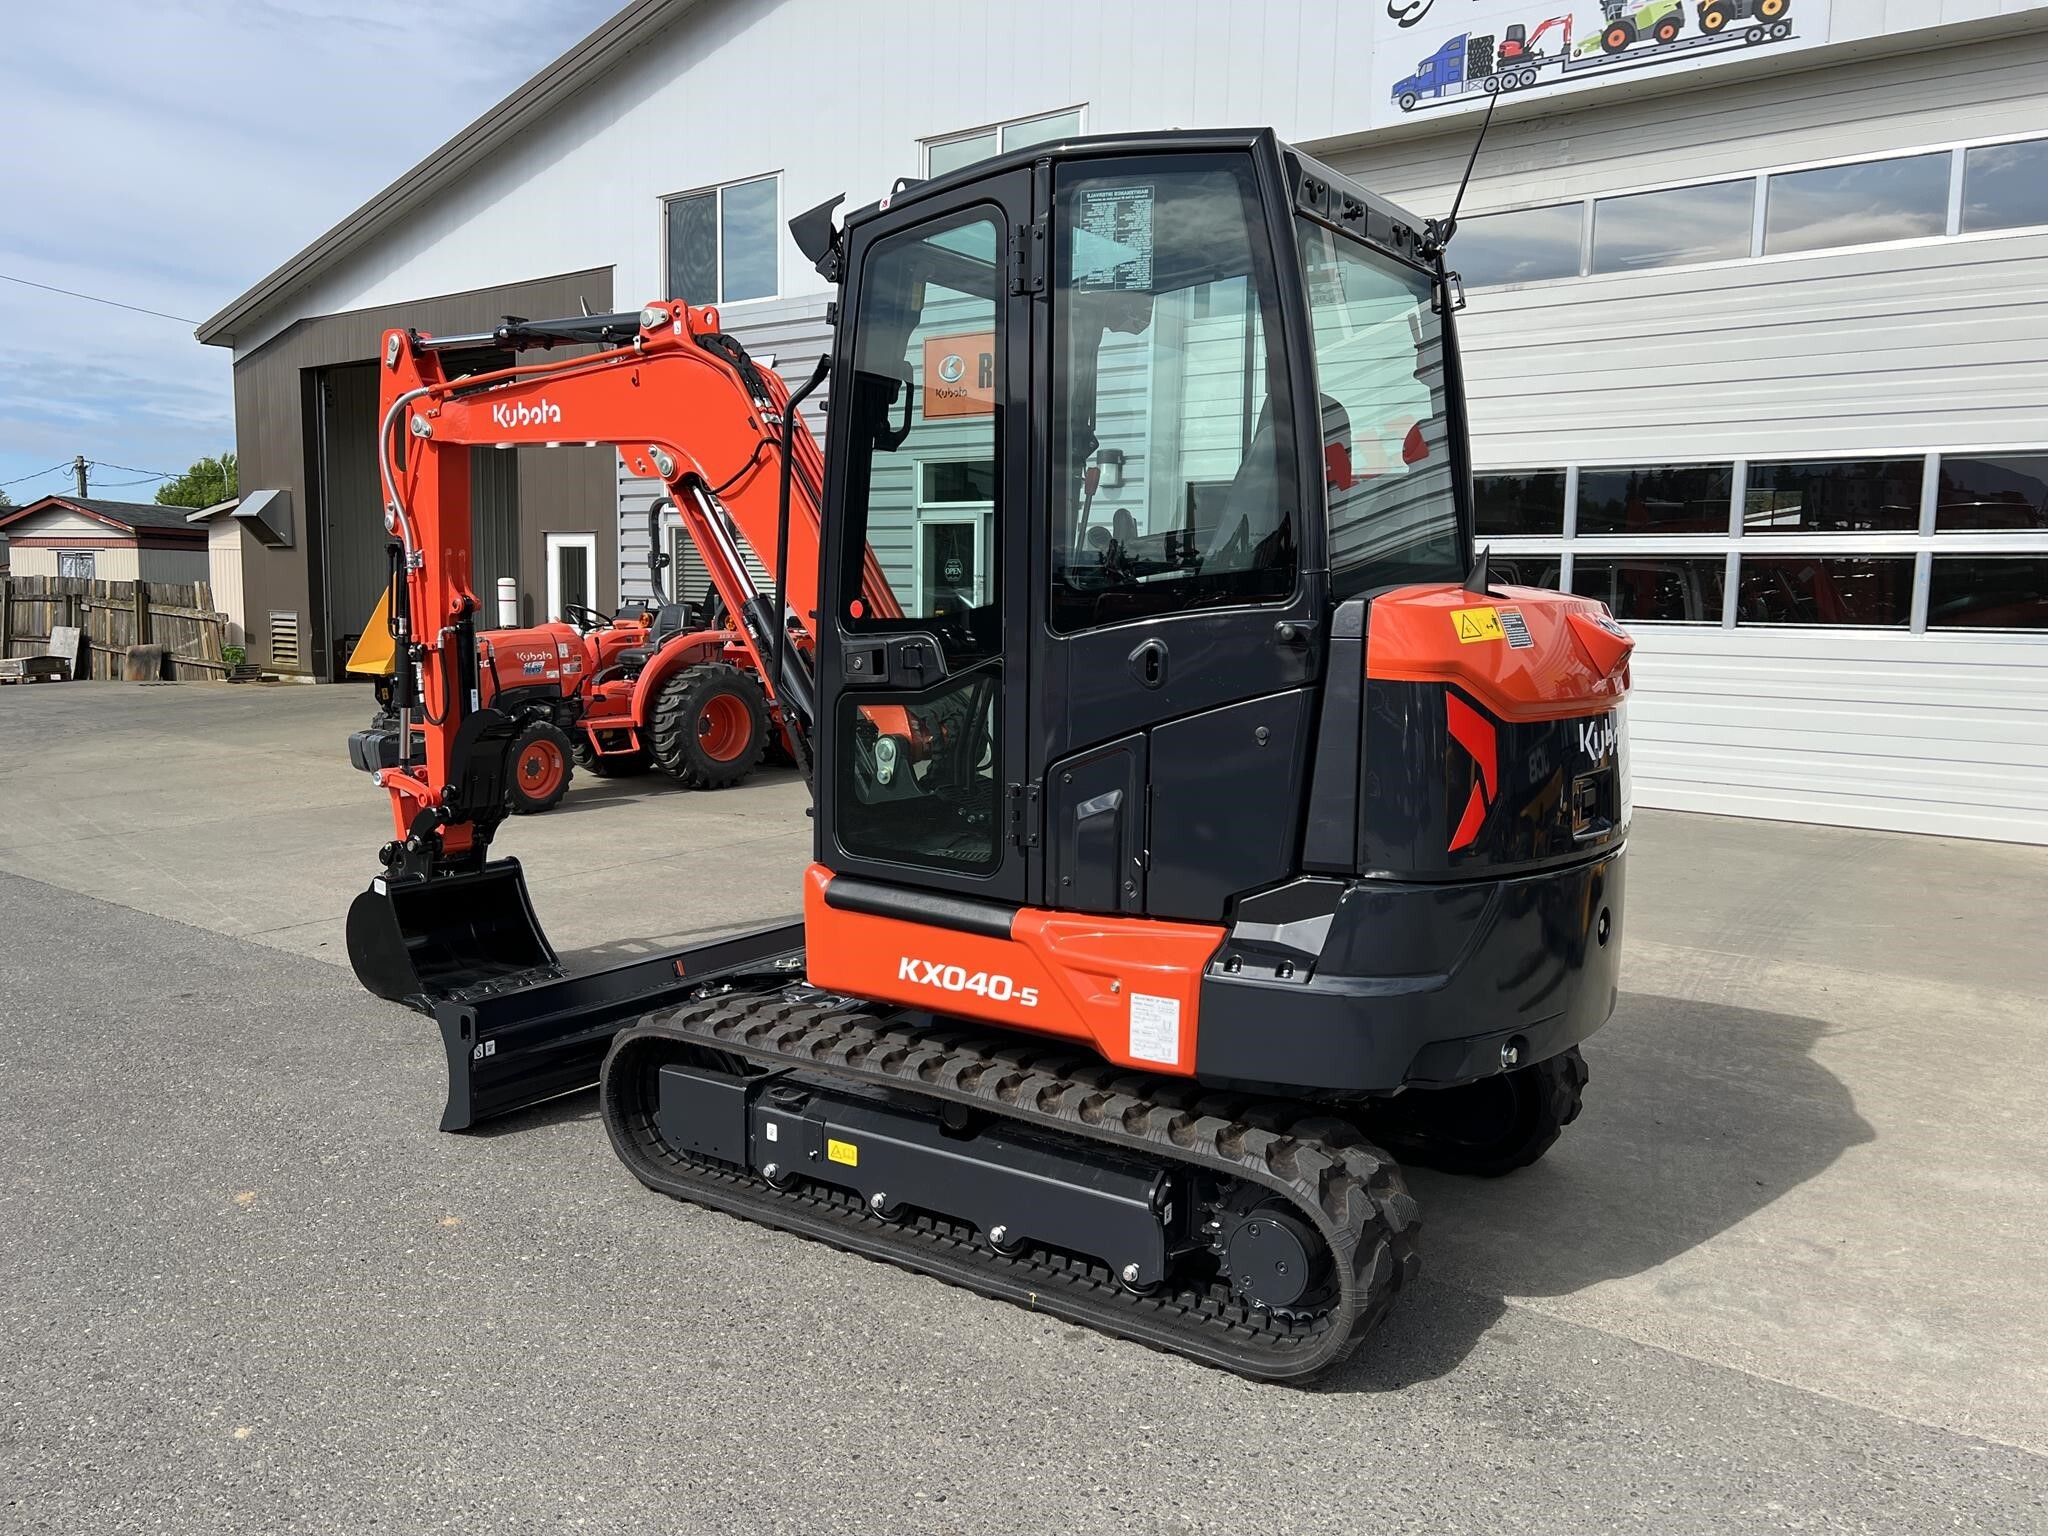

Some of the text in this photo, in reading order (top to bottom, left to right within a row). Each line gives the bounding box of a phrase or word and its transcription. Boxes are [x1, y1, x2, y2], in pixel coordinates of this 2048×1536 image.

[936, 386, 967, 399] Kubota
[493, 398, 561, 428] Kubota
[945, 567, 962, 575] OPEN
[516, 651, 552, 661] Kubota
[898, 956, 1039, 1007] KX040-5
